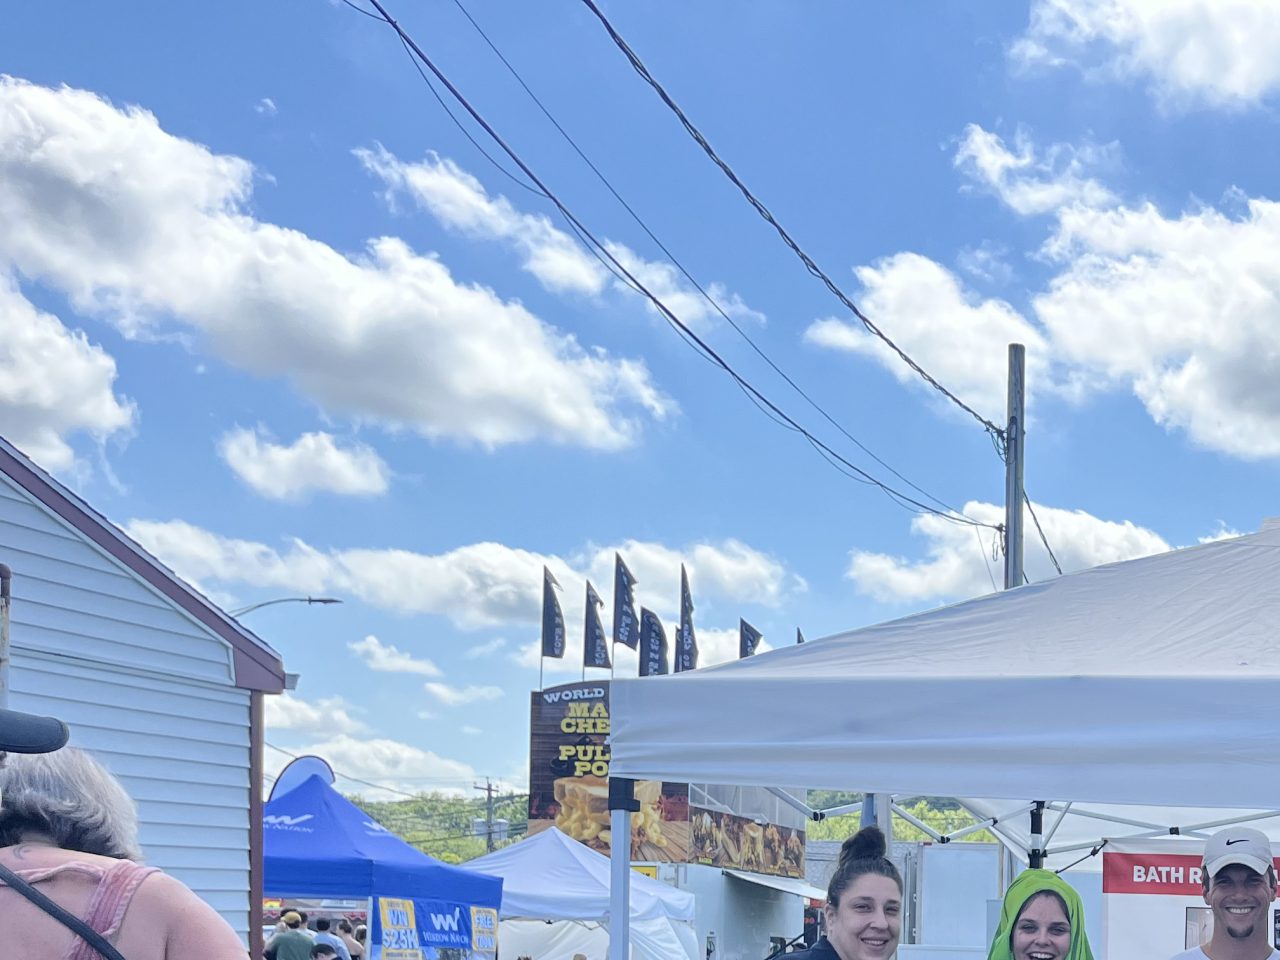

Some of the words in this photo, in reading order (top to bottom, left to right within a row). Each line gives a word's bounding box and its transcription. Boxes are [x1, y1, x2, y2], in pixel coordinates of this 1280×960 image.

[543, 688, 604, 703] WORLD
[567, 702, 609, 718] MA
[560, 717, 610, 734] CHE
[558, 745, 610, 761] PUL
[574, 761, 609, 777] PO
[1133, 865, 1184, 884] BATH
